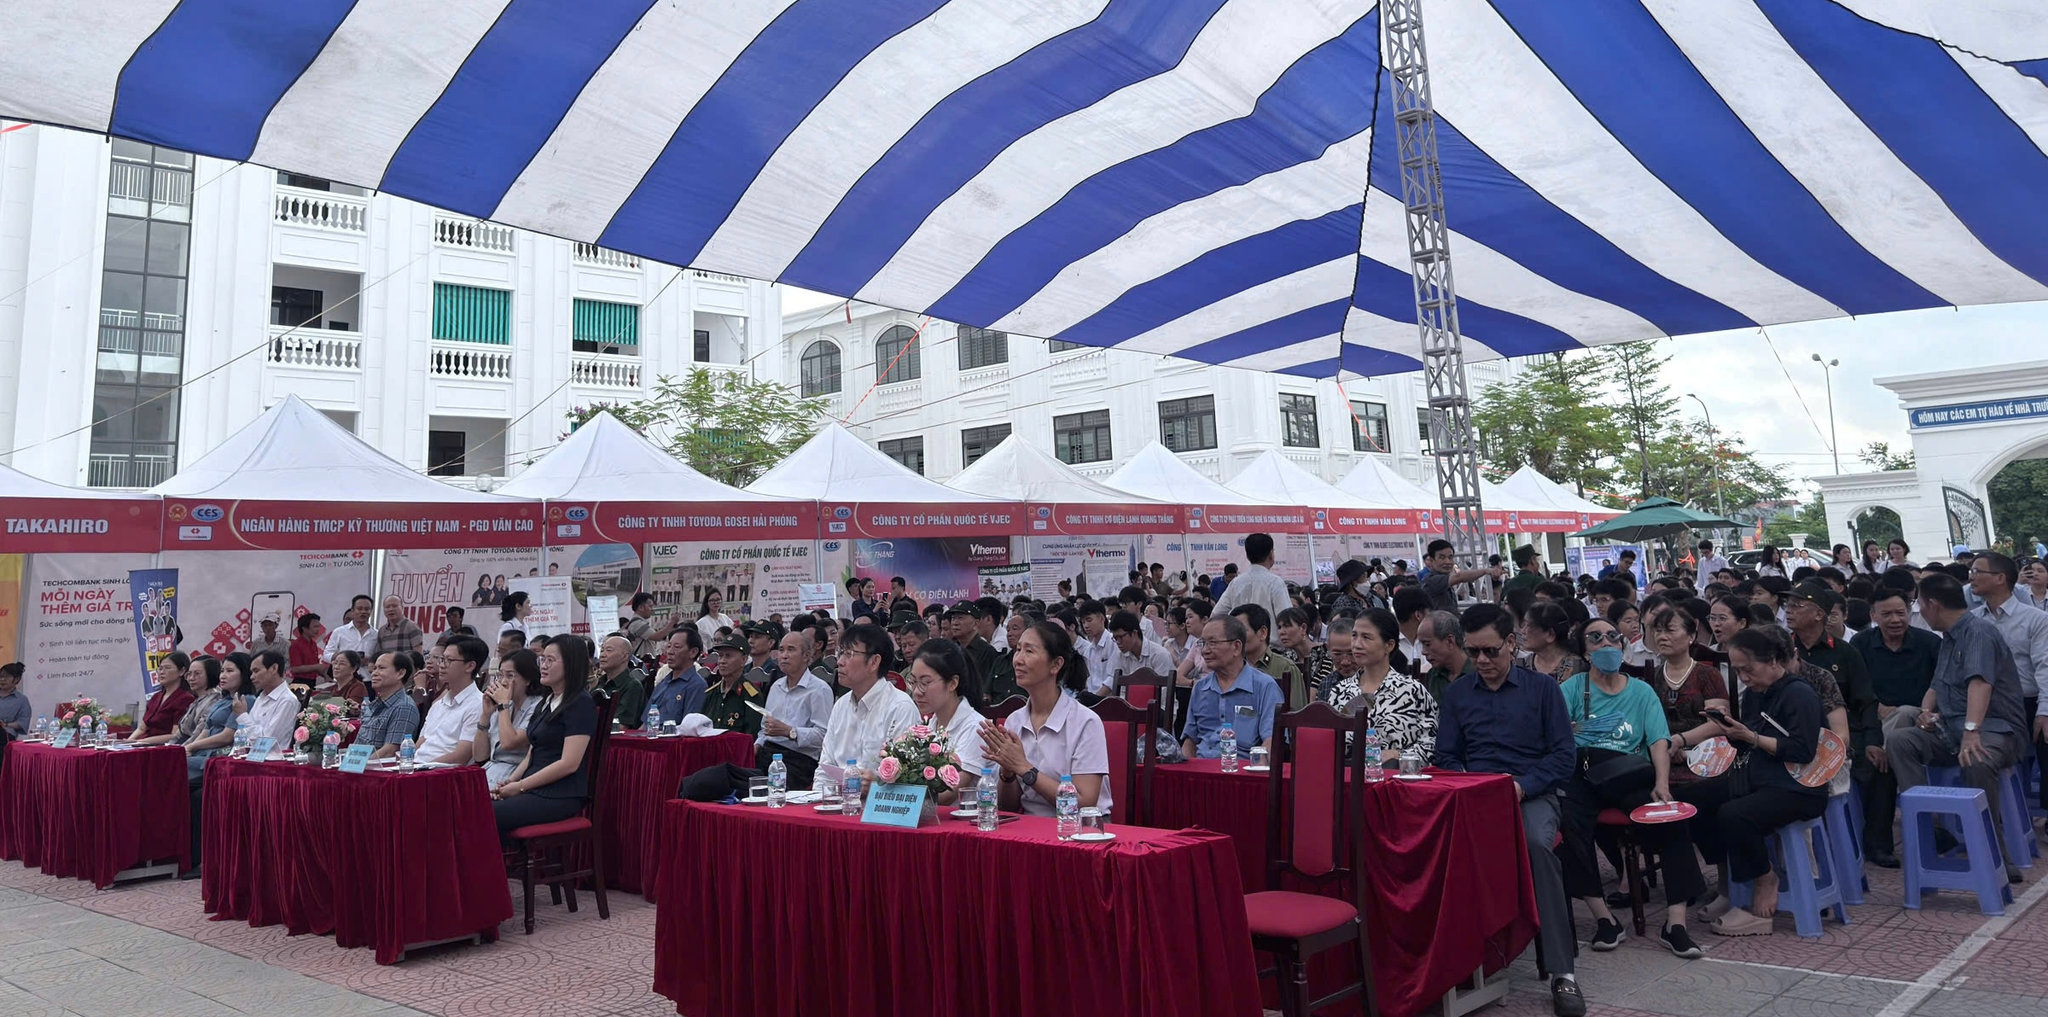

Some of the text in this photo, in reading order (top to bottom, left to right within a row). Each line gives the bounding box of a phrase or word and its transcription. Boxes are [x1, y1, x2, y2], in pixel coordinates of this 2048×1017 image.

[1918, 411, 1934, 423] HÔM
[1935, 411, 1948, 421] NAY
[1950, 408, 1965, 420] CÁC
[1966, 408, 1977, 419] EM
[1988, 404, 2003, 417] HÀO
[2015, 401, 2031, 414] NHÀ
[5, 518, 109, 534] TAKAHIRO
[240, 516, 274, 533] NGÂN
[278, 516, 310, 533] HÀNG
[313, 519, 345, 533] TMCP
[348, 517, 362, 533] KỸ
[366, 518, 408, 533] THƯƠNG
[411, 518, 433, 535] VIỆT
[435, 519, 459, 532] NAM
[469, 519, 489, 532] PGD
[515, 519, 533, 531] CAO
[618, 513, 797, 529] CÔNG TY TNHH TOYODA GOSEI HẢI PHÒNG
[872, 512, 1010, 526] CÔNG TY CỔ PHẦN QUỐC TẾ VJEC
[1065, 514, 1080, 524] CÔNG
[1082, 515, 1088, 524] TY
[1338, 516, 1355, 525] CÔNG
[1356, 517, 1363, 525] TY
[1364, 517, 1379, 525] TNHH
[1391, 517, 1407, 525] LONG
[652, 545, 678, 556] VJEC
[700, 548, 720, 560] CÔNG
[721, 549, 730, 559] TY
[764, 545, 781, 558] QUỐC
[792, 547, 808, 557] VJEC
[1088, 548, 1126, 559] Vthermo
[1166, 542, 1182, 551] CÔNG
[1215, 543, 1228, 551] LONG
[300, 552, 348, 560] TECHCOMBANK
[43, 579, 100, 587] TECHCOMBANK
[391, 564, 465, 604] TUYỂN
[41, 588, 115, 602] MỖI NGÀY
[41, 602, 82, 615] THÊM
[86, 601, 111, 613] GIÁ
[79, 669, 94, 677] 24/7
